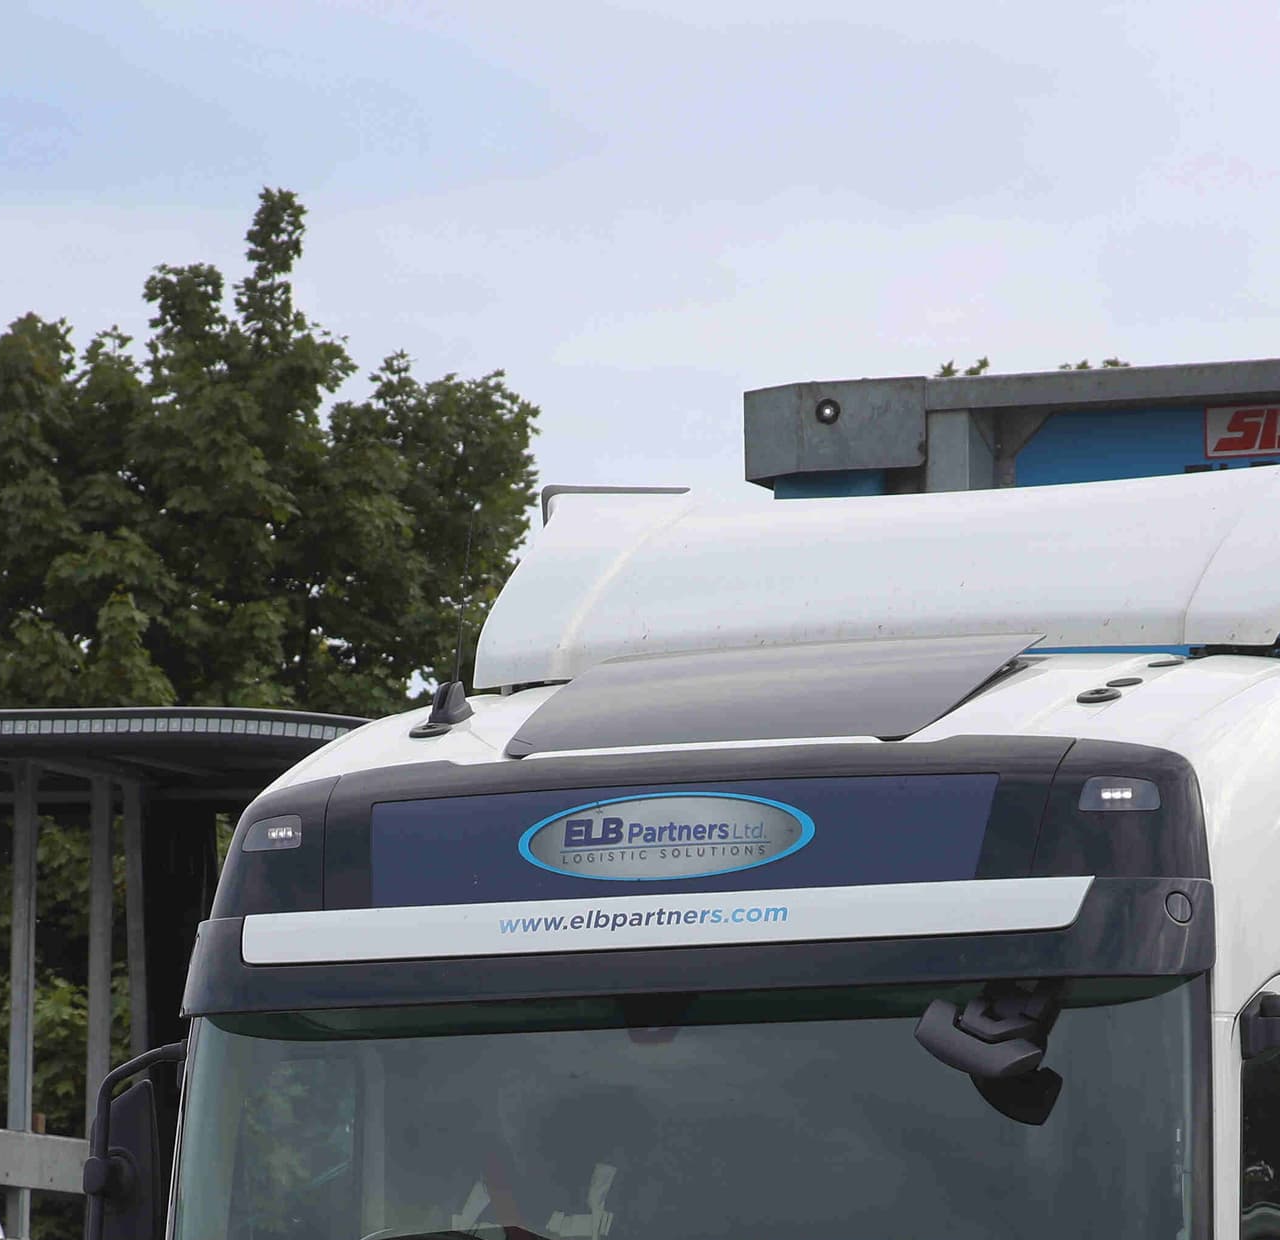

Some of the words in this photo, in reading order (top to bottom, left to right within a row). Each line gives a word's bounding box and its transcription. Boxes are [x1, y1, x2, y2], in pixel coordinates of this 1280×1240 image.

[564, 817, 624, 848] ELB
[628, 821, 729, 844] Partners
[733, 821, 767, 840] Ltd.
[562, 850, 647, 864] LOGISTIC
[660, 845, 766, 859] SOLUTIONS
[499, 903, 789, 935] www.elbpartners.com
